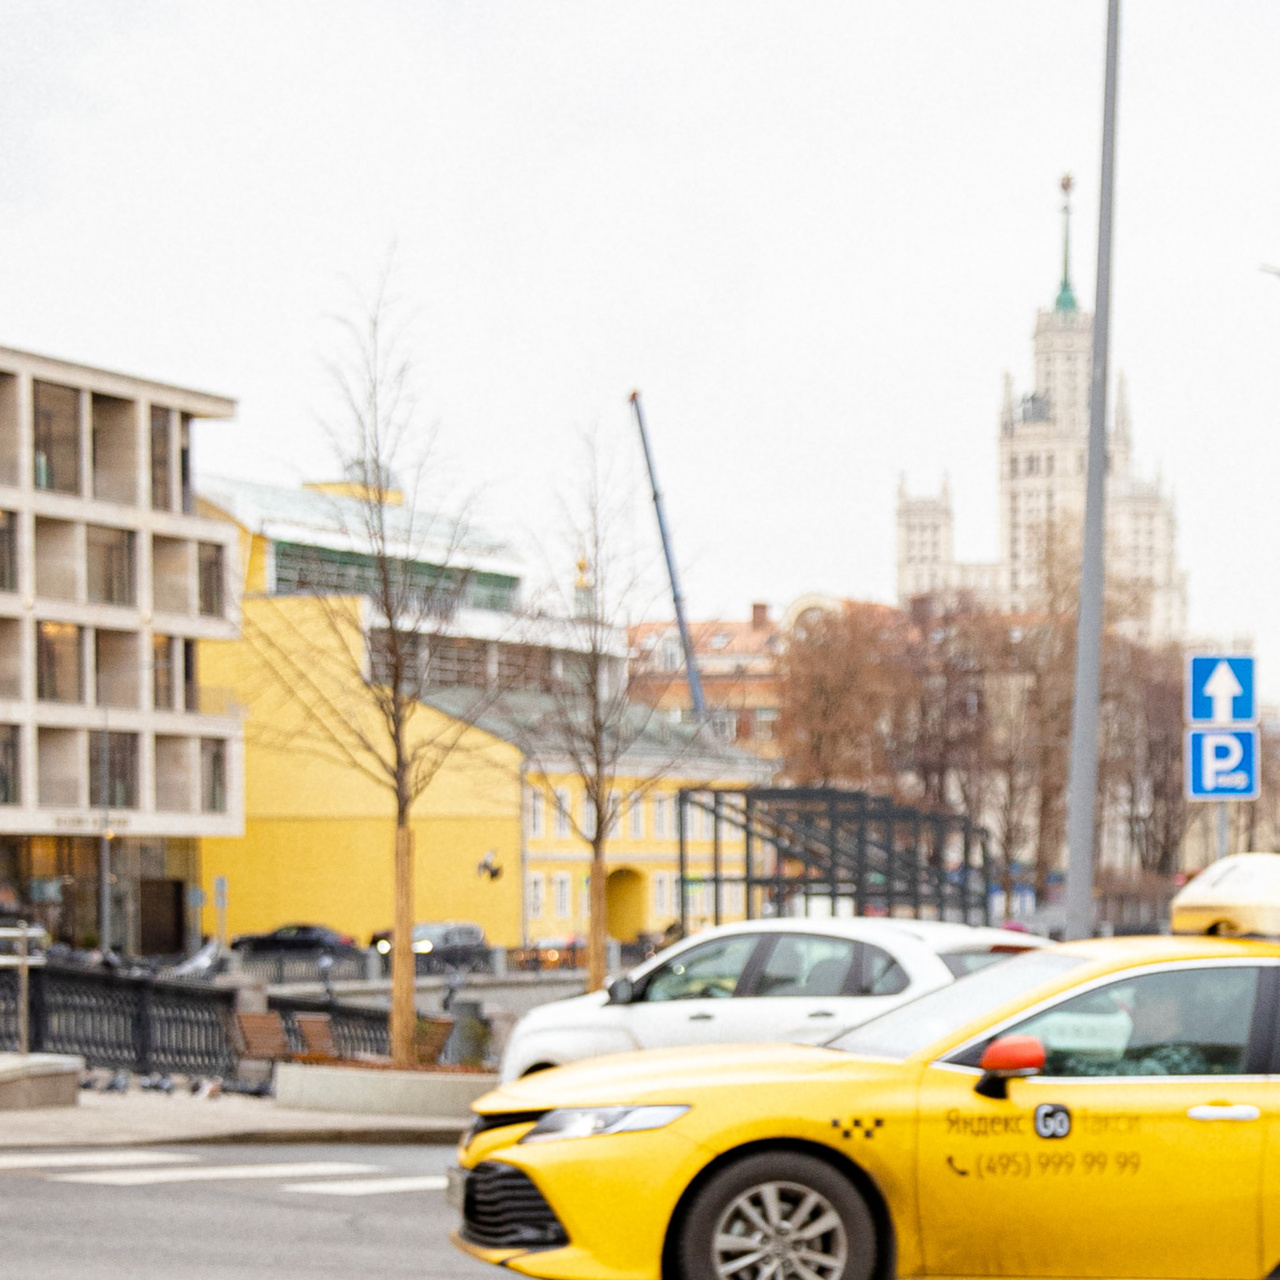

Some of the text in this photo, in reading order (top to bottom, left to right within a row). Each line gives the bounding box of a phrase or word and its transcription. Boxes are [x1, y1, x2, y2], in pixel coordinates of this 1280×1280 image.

[946, 1108, 1026, 1137] Яндекс
[1035, 1103, 1071, 1138] Go
[975, 1151, 1142, 1179] (495) 999 99 99
